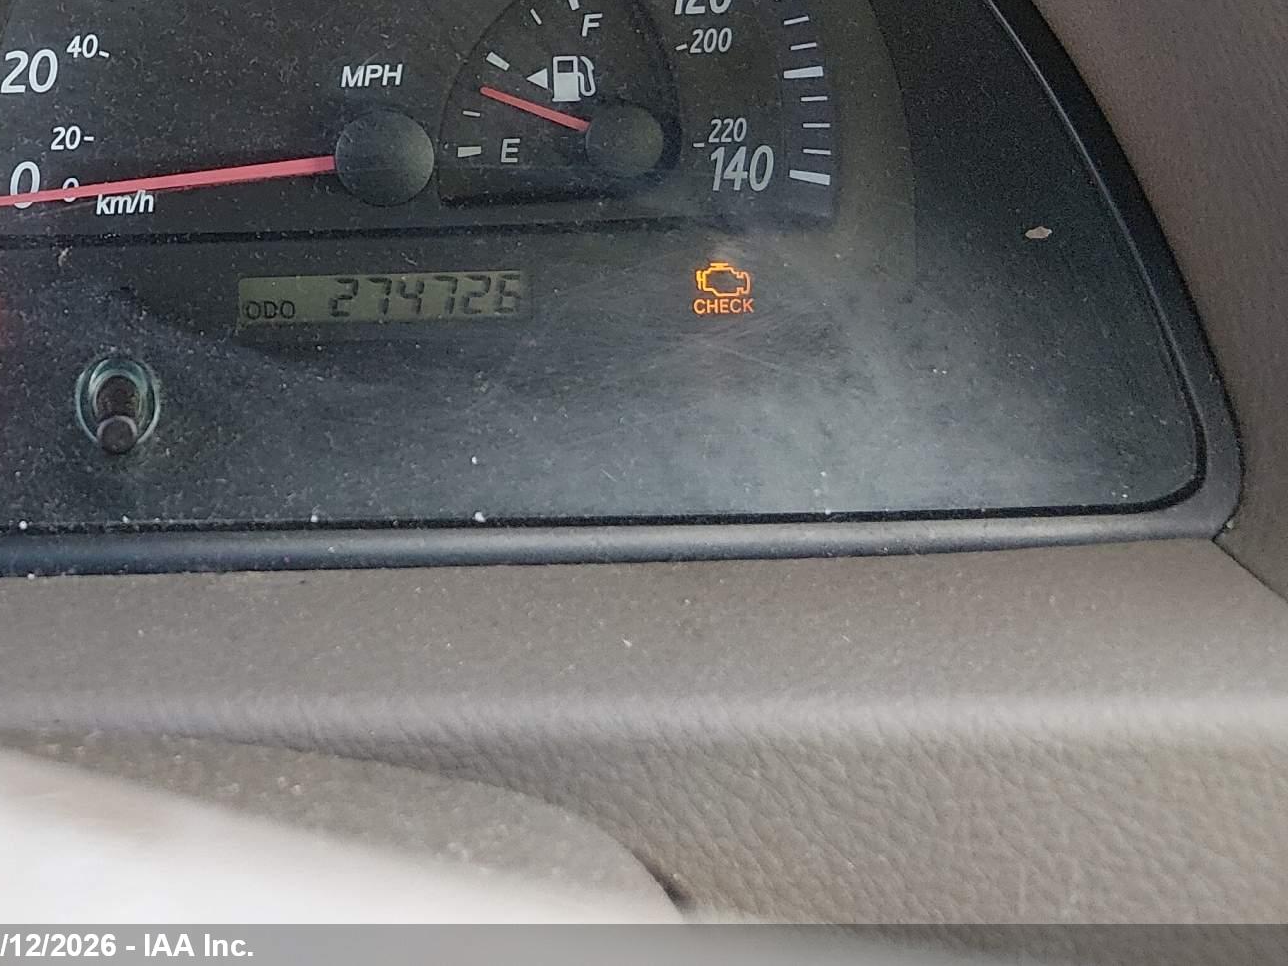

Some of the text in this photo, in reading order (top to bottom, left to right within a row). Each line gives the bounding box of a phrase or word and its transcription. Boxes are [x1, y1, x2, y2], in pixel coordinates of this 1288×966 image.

[582, 14, 602, 36] F
[67, 35, 98, 58] 40
[690, 28, 732, 53] 200
[1, 49, 57, 93] 20
[341, 64, 402, 87] MPH
[51, 126, 81, 150] 20
[709, 118, 747, 142] 220
[501, 139, 520, 162] E
[711, 146, 774, 191] 140
[10, 161, 40, 209] 0
[95, 189, 155, 215] km/h
[245, 274, 521, 319] ODO 274726
[693, 298, 754, 315] CHECK
